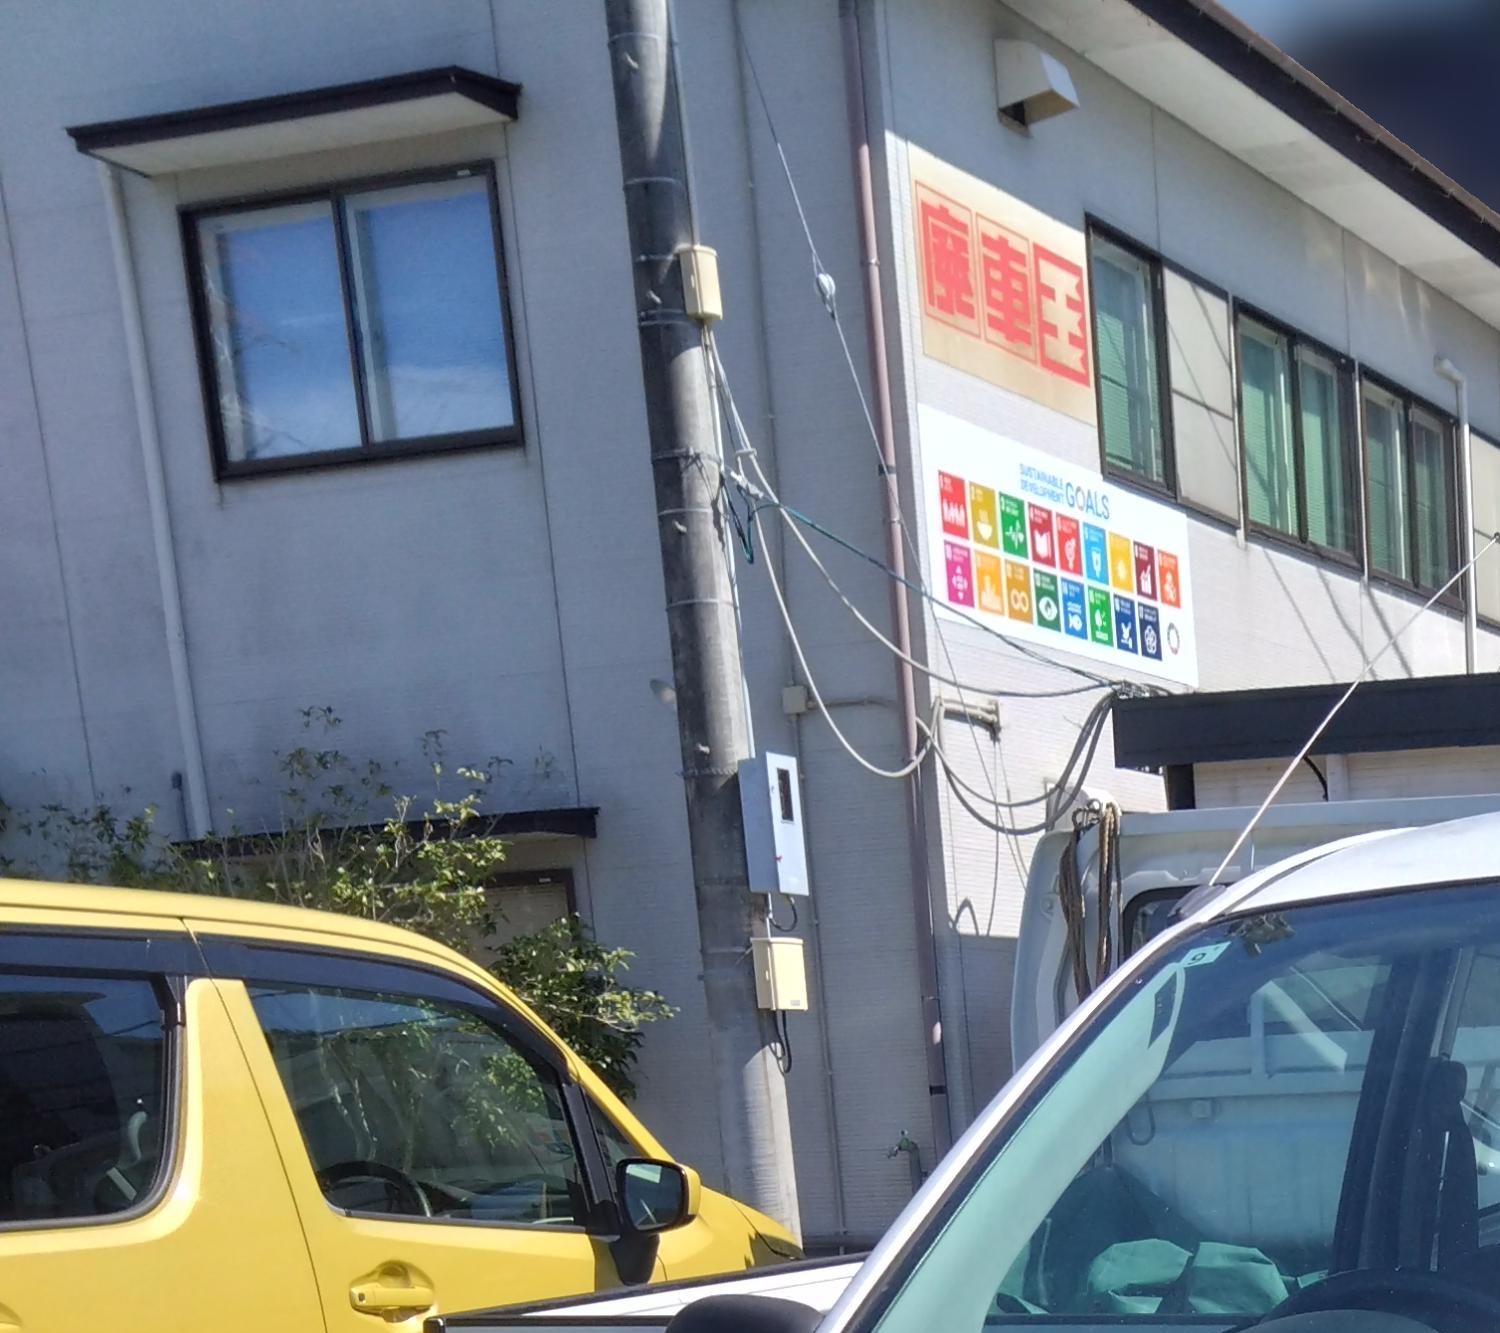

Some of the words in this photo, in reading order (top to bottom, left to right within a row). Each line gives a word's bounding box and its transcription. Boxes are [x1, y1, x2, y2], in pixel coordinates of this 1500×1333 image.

[1019, 462, 1064, 490] SUSTAINABLE
[1020, 479, 1065, 504] DEVELOPMENT
[1065, 482, 1110, 520] GOALS
